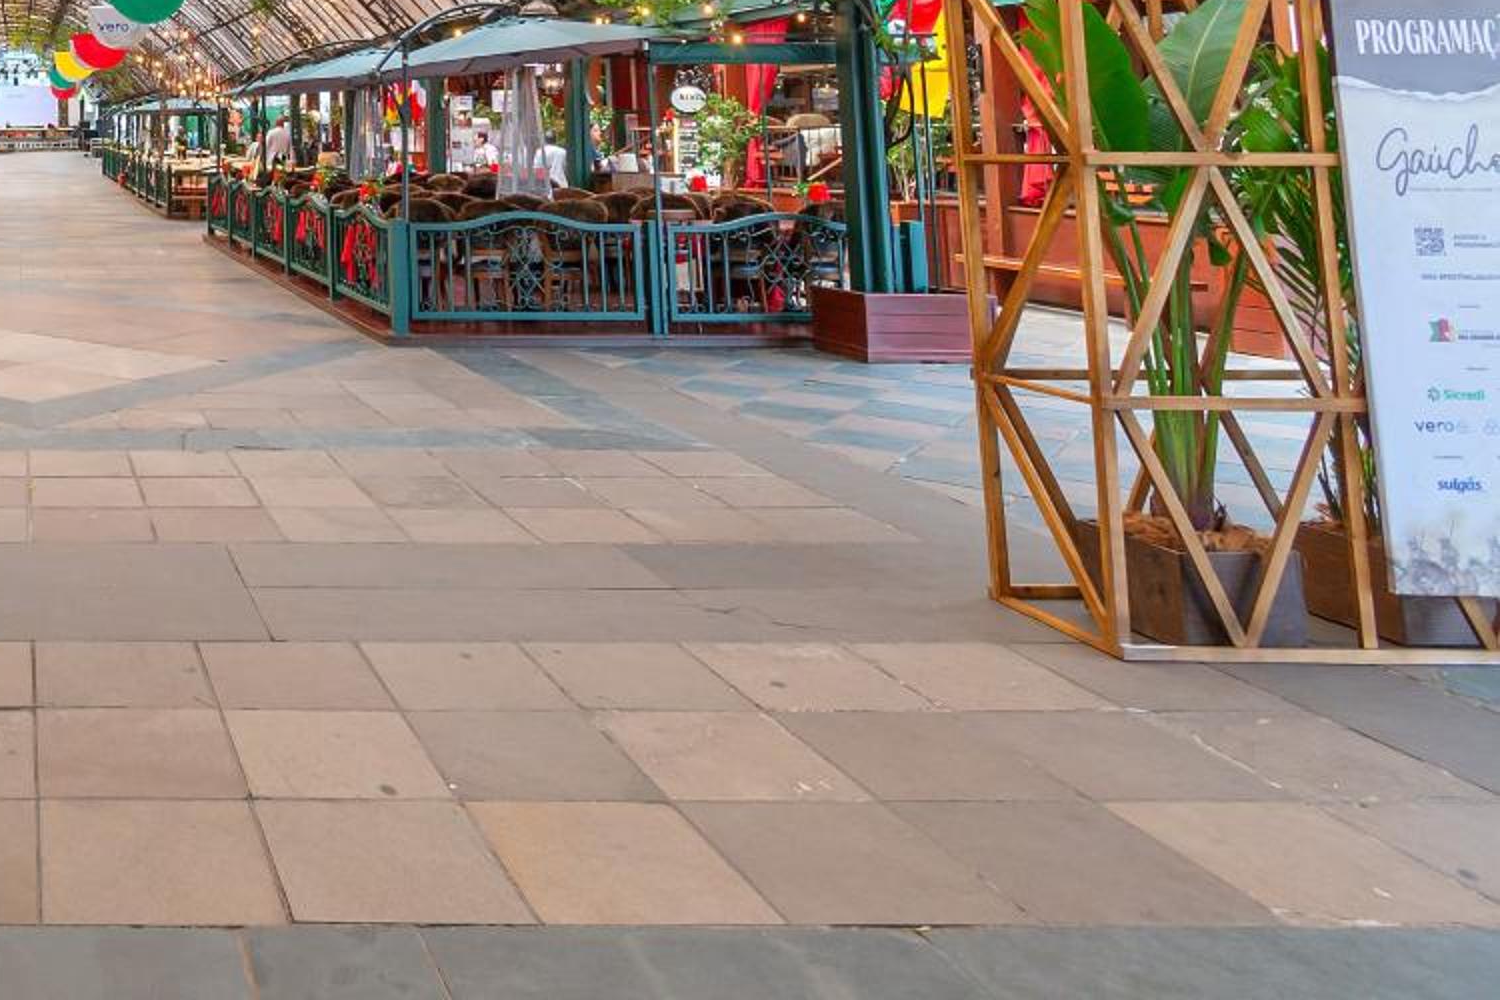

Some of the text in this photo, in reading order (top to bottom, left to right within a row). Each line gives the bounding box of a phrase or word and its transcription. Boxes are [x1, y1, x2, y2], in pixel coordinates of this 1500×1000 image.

[97, 22, 130, 33] vero
[1354, 13, 1500, 60] PROGRAMAÇ
[1414, 421, 1455, 433] vero
